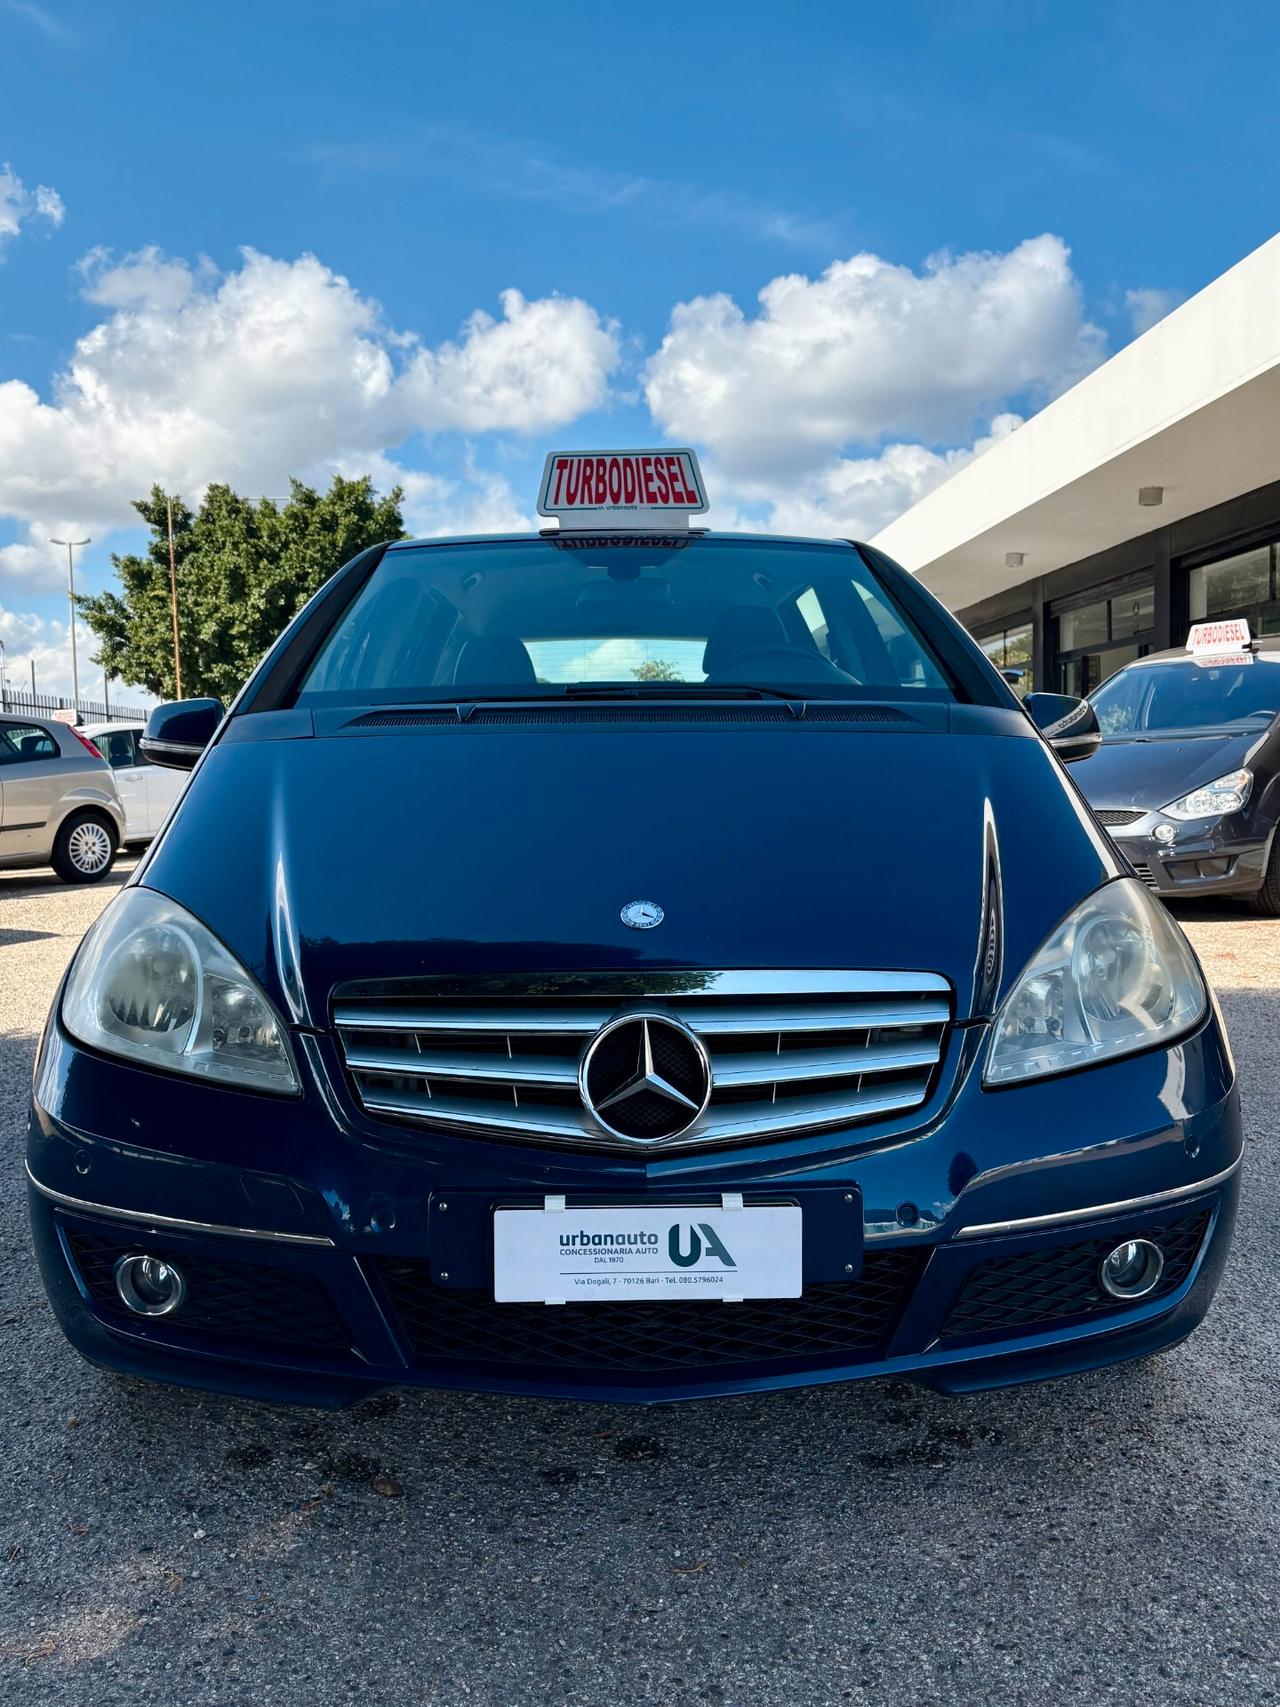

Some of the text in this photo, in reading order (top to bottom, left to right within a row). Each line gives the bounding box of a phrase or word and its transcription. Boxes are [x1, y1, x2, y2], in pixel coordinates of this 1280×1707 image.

[553, 456, 698, 505] TURBODIESEL
[1193, 623, 1246, 646] TURBODIESEL
[559, 1230, 658, 1246] urbanauto
[668, 1223, 737, 1267] UA
[559, 1247, 658, 1256] CONCESSIONARIA AUTO
[623, 1277, 645, 1285] 70126
[645, 1277, 660, 1285] Bari
[678, 1276, 724, 1284] 080.5796024
